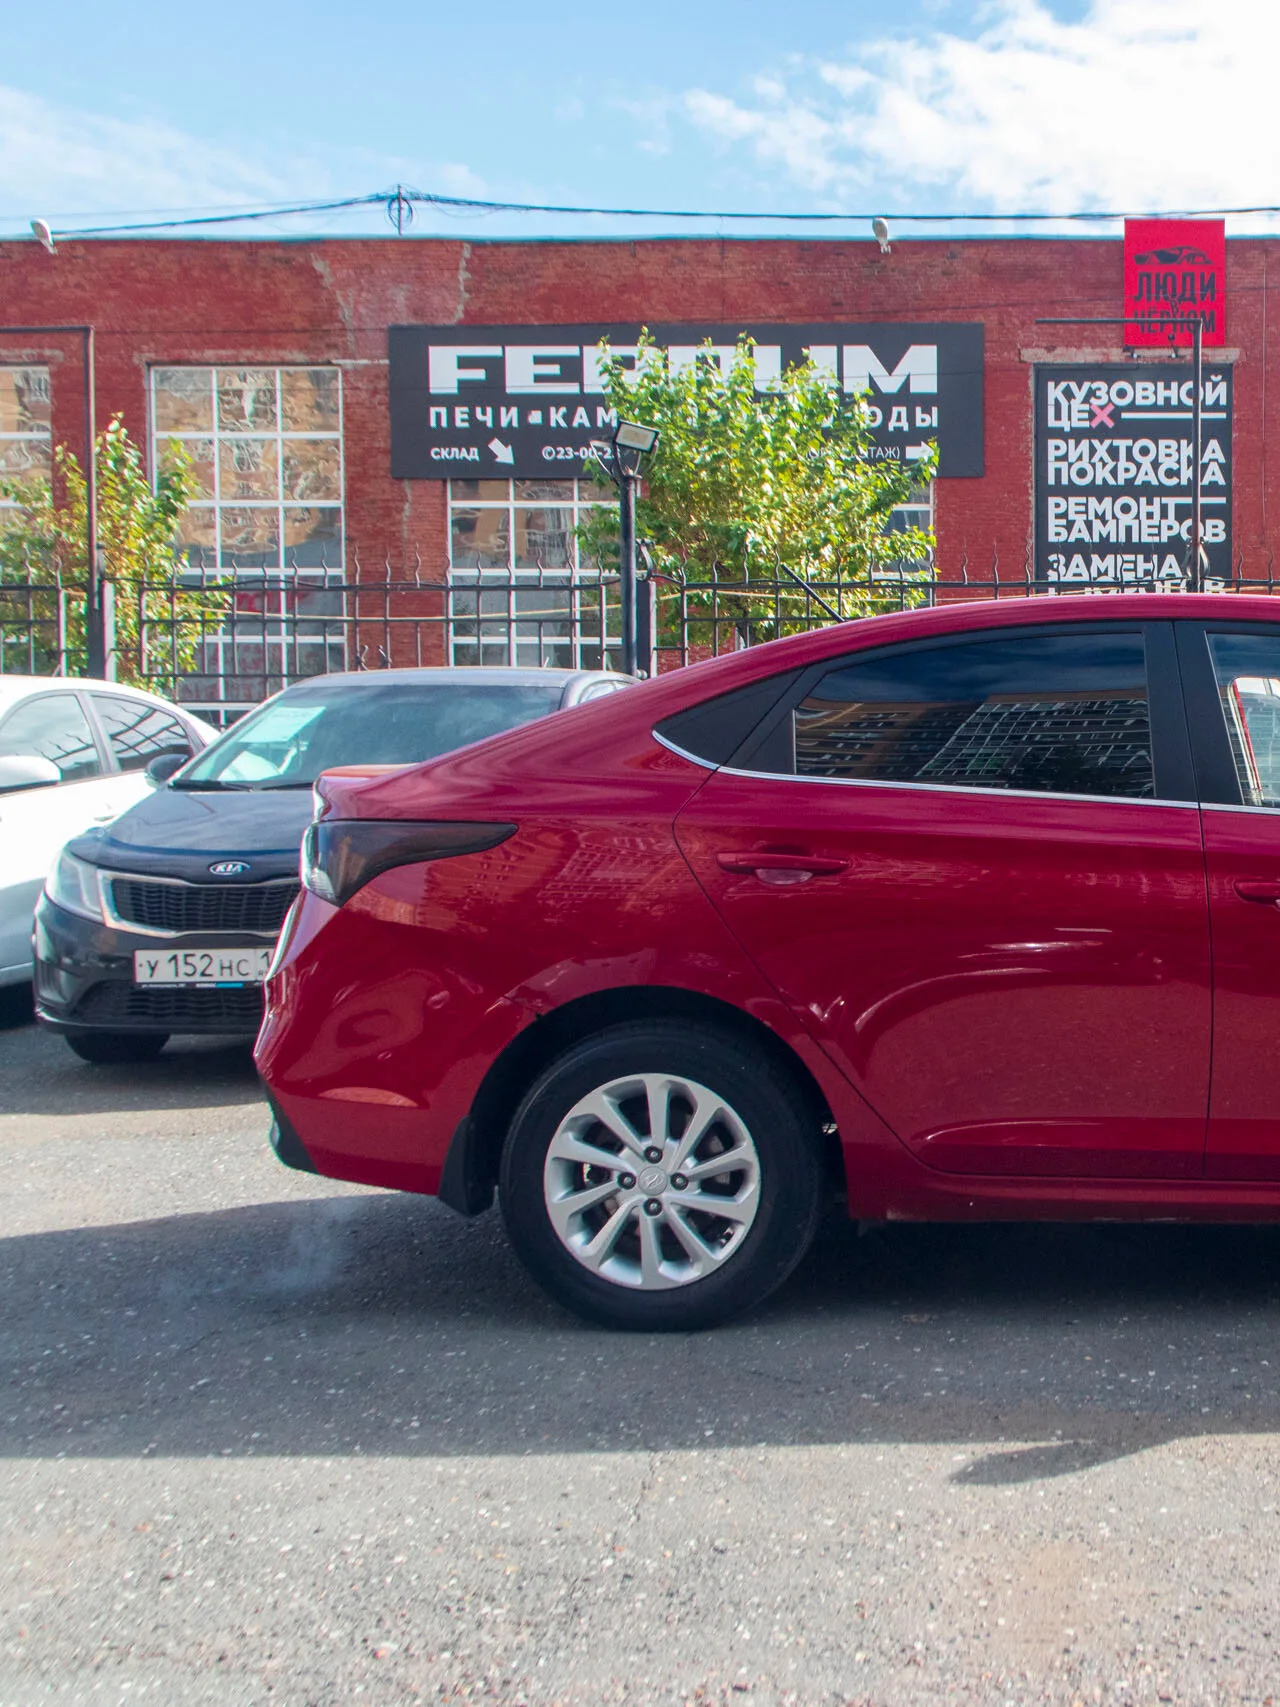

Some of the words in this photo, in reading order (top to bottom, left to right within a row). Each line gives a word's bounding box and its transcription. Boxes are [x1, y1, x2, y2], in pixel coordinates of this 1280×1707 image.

[1134, 272, 1216, 305] ЛЮДИ
[1047, 375, 1227, 406] КУЗОВНОЙ
[429, 406, 519, 429] ПЕЧИ
[1047, 402, 1115, 432] ЦЕХ
[430, 446, 480, 462] СКЛАД
[1047, 496, 1227, 521] РЕМОНТ
[1047, 518, 1227, 544] БАМПЕРОВ
[1047, 553, 1184, 580] ЗАМЕНА
